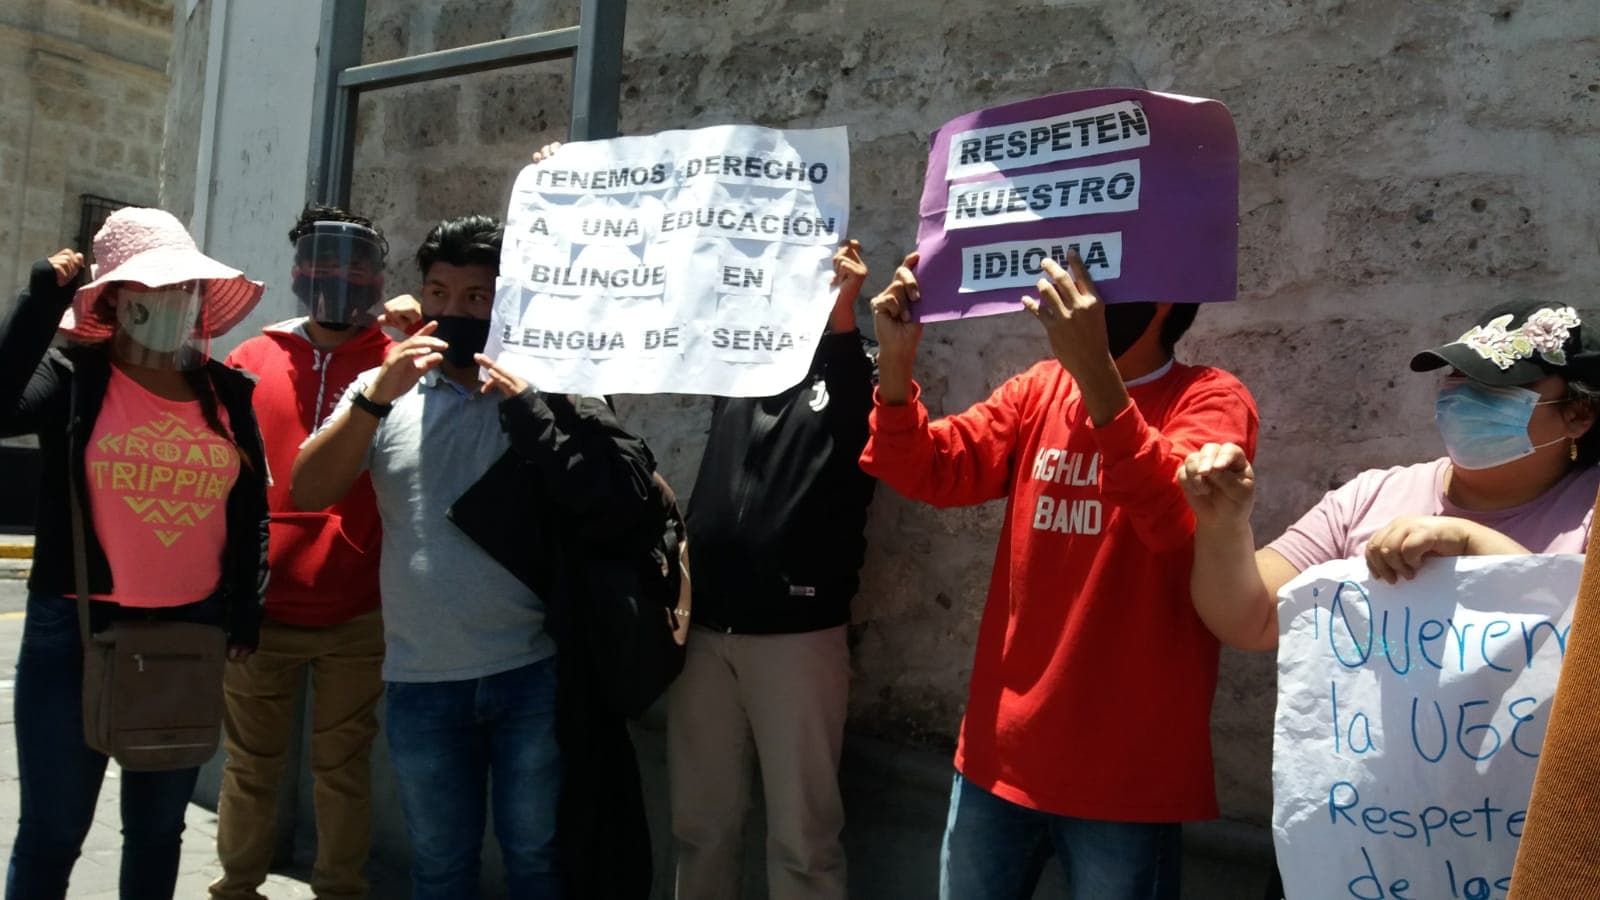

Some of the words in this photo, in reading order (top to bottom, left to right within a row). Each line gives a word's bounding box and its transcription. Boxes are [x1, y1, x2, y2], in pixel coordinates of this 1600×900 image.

[960, 108, 1148, 165] RESPETEN
[686, 155, 828, 184] DERECHO
[955, 172, 1135, 220] NUESTRO
[529, 217, 549, 236] A
[582, 218, 639, 237] UNA
[661, 207, 835, 237] EDUCACIÓN
[530, 263, 666, 288] BILINGÜE
[722, 265, 764, 288] EN
[502, 325, 625, 351] LENGUA
[644, 327, 680, 350] DE
[124, 435, 229, 468] ROAD
[1033, 495, 1102, 535] BAND
[1331, 680, 1376, 753] la
[1348, 846, 1414, 900] de
